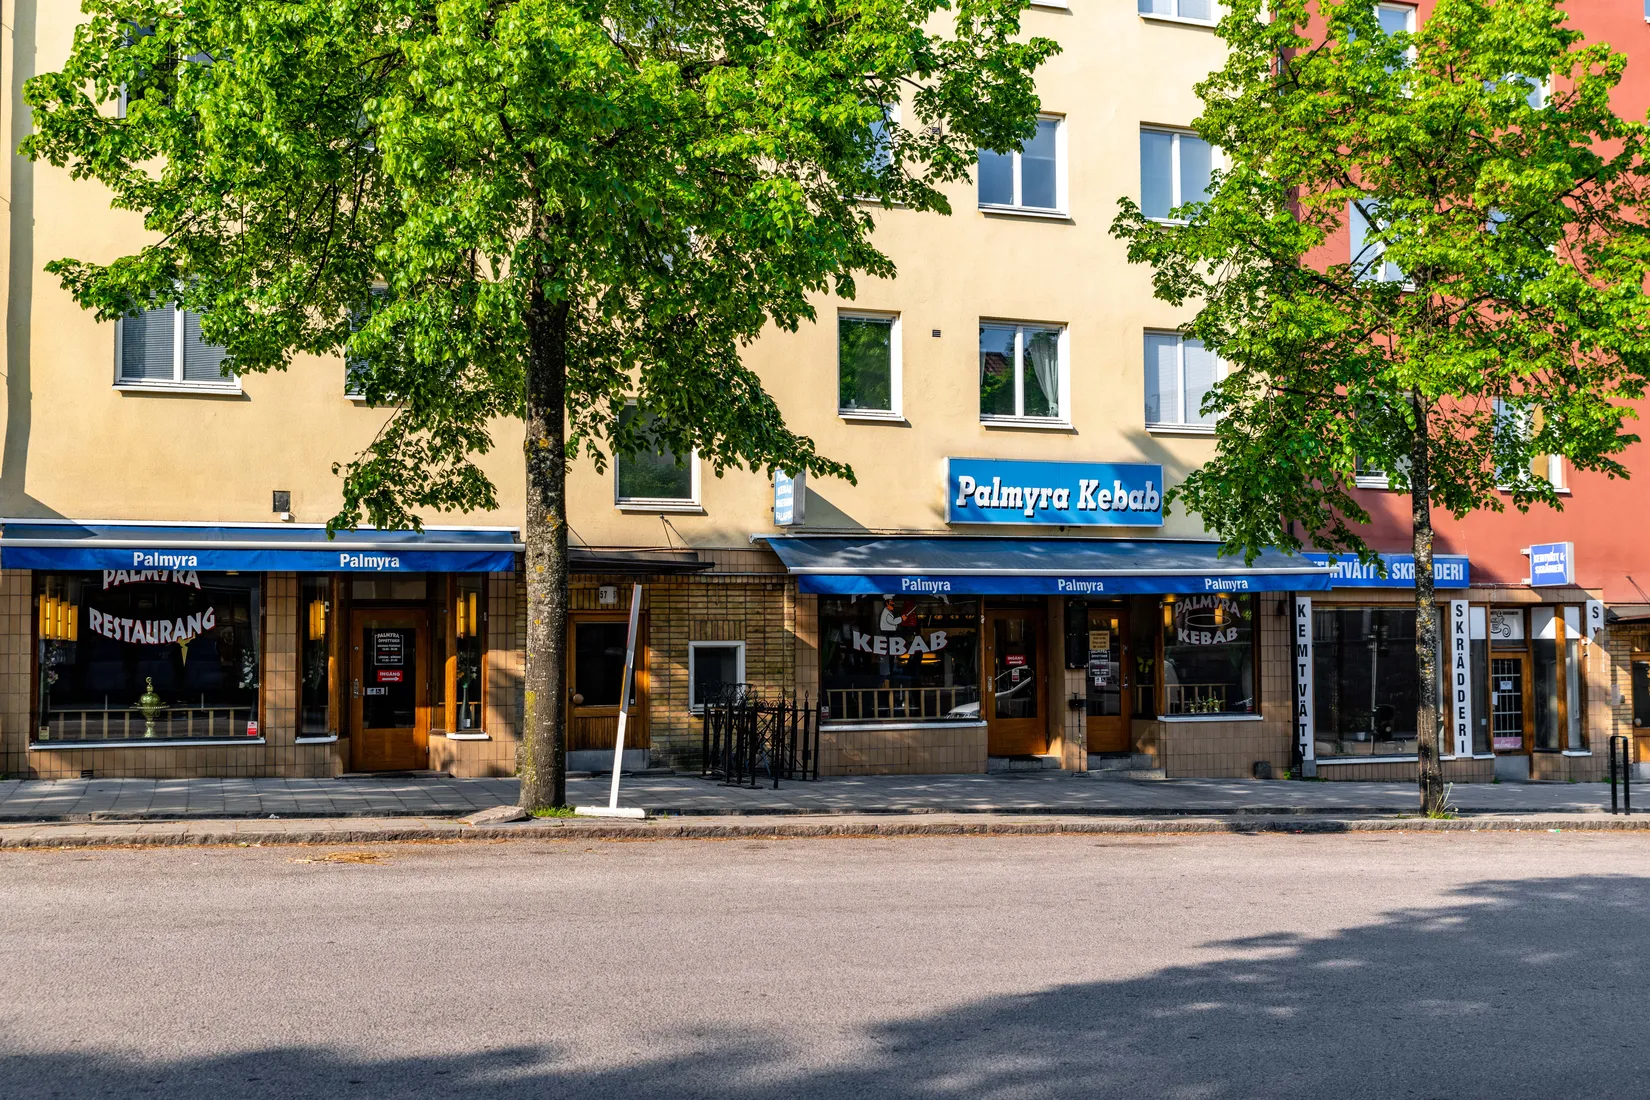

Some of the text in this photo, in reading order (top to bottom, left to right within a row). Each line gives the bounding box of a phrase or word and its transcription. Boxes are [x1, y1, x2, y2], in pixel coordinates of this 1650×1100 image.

[956, 476, 1161, 518] Palmyra Kebab
[133, 551, 198, 569] Palmyra
[340, 553, 400, 571] Palmyra
[1392, 563, 1463, 581] SKRDERI
[901, 578, 951, 594] Palmyra
[1057, 578, 1104, 594] Palmyra
[1204, 578, 1249, 592] Palmyra
[600, 590, 608, 599] 57
[1174, 595, 1241, 618] PALMYRA
[89, 606, 216, 645] RESTAURANG
[853, 630, 948, 656] KEBAB
[1177, 626, 1239, 645] KEBAB
[1297, 604, 1308, 758] KEMTVÄTT
[1455, 603, 1467, 754] SKRÄDDERI
